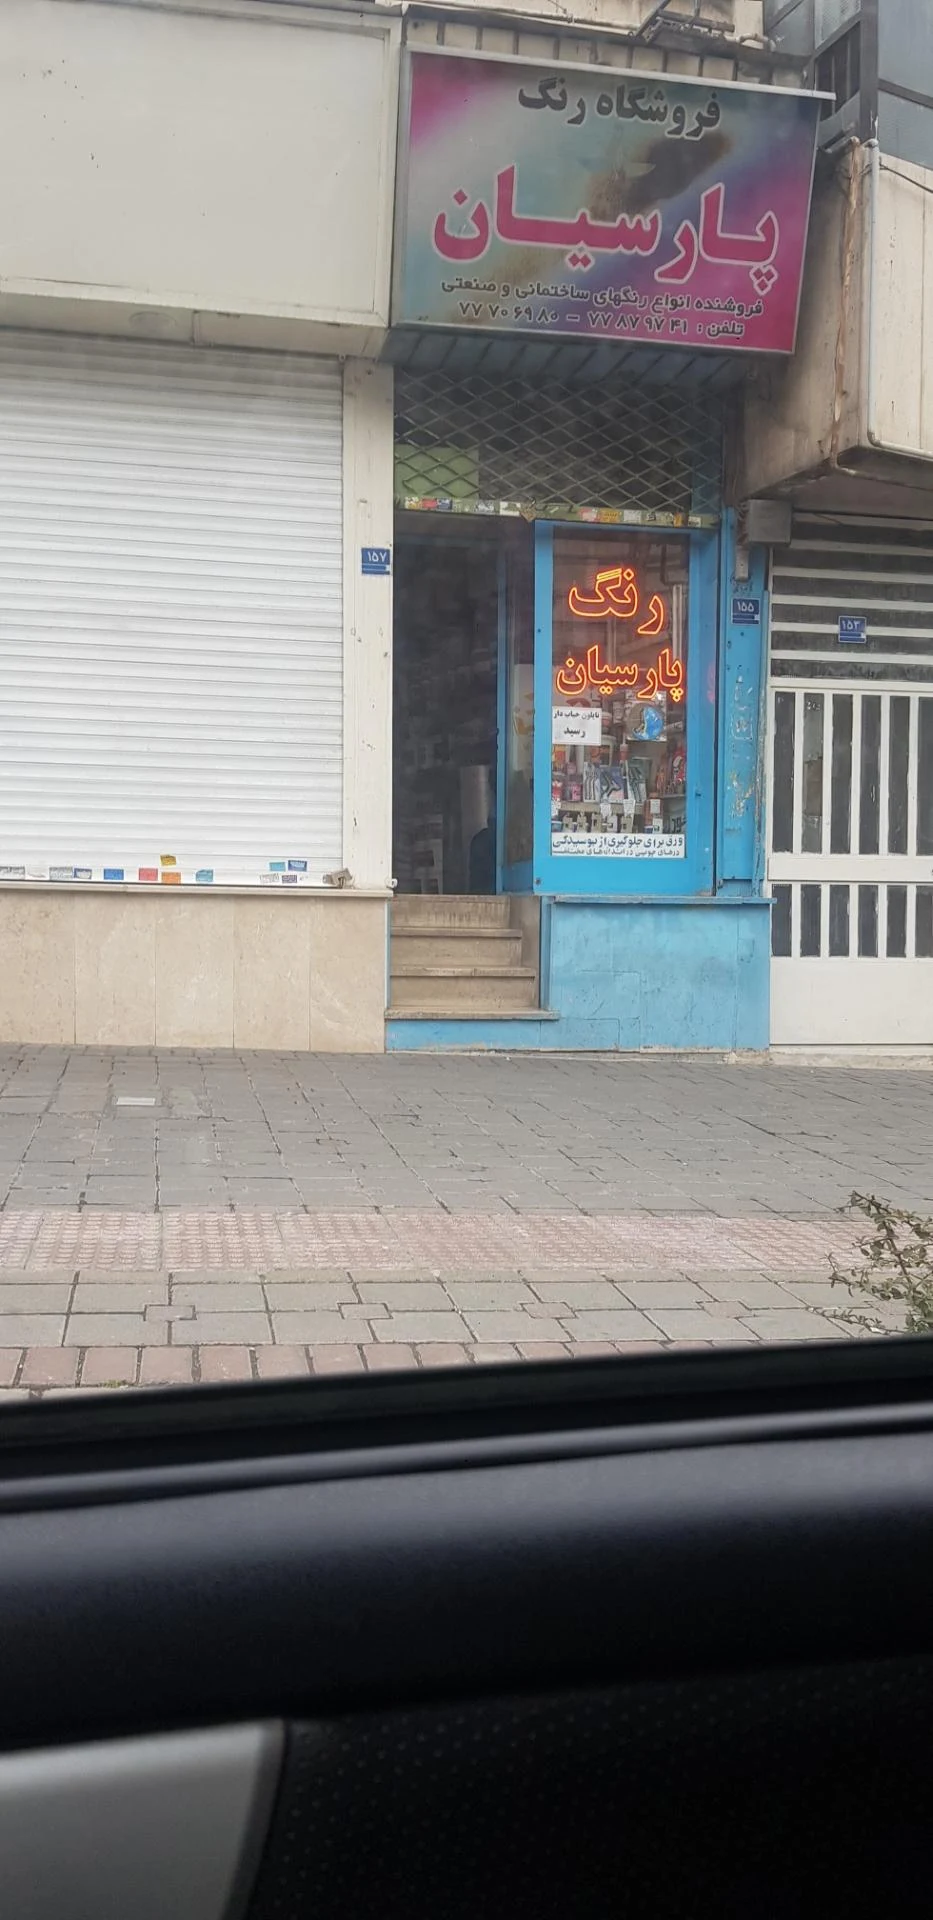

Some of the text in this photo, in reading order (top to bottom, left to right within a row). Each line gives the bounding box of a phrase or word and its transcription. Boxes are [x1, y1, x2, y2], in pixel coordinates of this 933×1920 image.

[518, 78, 721, 138] فروشگاه رنگ
[433, 163, 779, 296] پارسیان
[441, 277, 764, 319] فروشنده انواع رنگهای ساختمانی و صنعتی
[367, 550, 387, 563] ۱۵۷
[567, 567, 665, 635] رنگ
[736, 601, 755, 612] ۱۵۵
[556, 644, 685, 703] پارسیان
[563, 727, 586, 738] رسید
[552, 834, 598, 848] پوسیدگی
[599, 836, 607, 848] از
[607, 835, 643, 849] جلوگیری
[643, 836, 665, 849] برای
